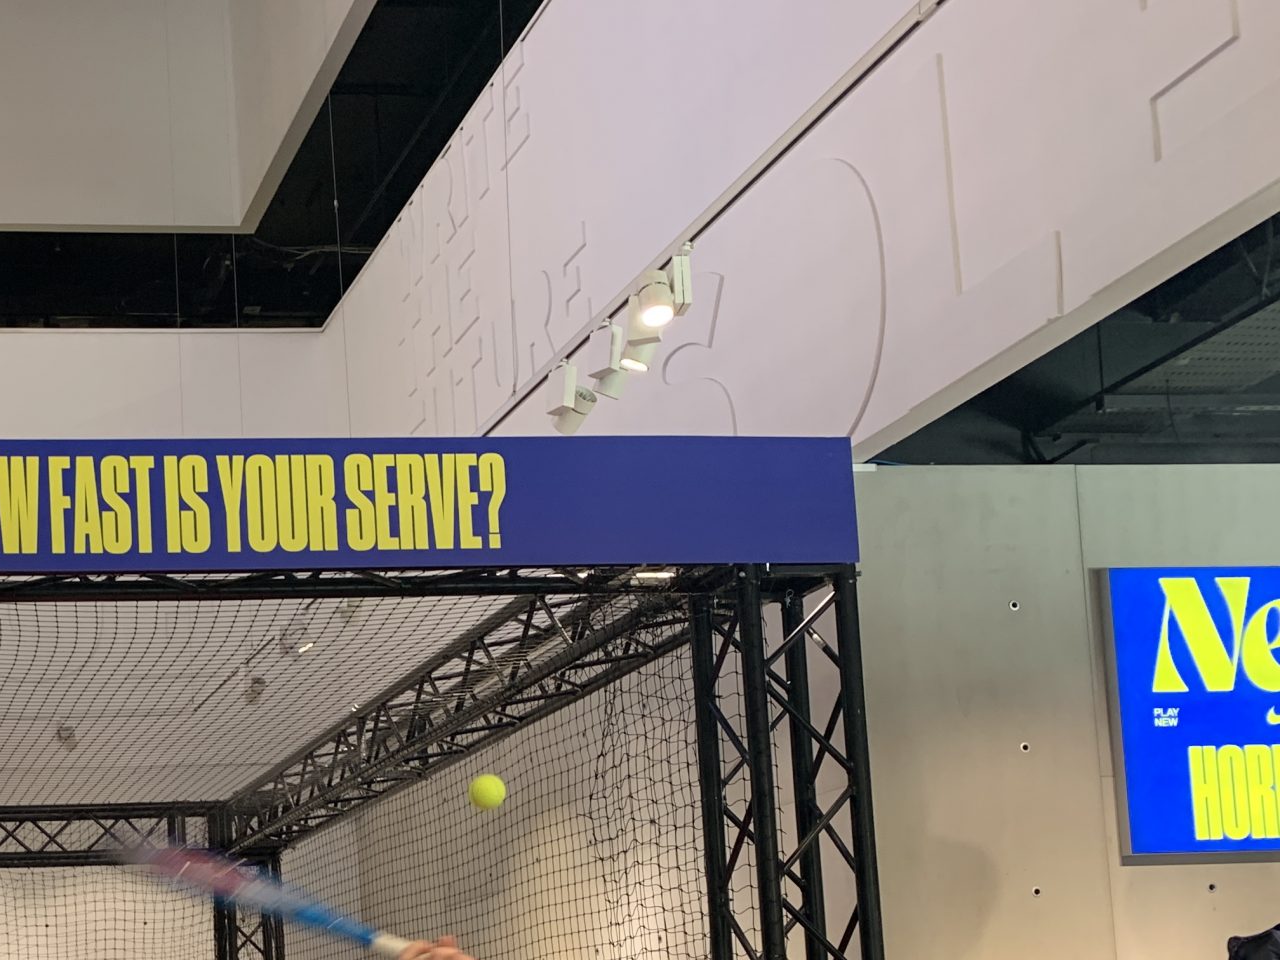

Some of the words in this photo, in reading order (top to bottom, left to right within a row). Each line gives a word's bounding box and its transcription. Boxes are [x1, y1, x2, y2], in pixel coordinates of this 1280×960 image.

[48, 455, 155, 554] FAST
[163, 454, 211, 553] IS
[216, 454, 337, 553] YOUR
[342, 452, 506, 551] SERVE?
[1153, 707, 1180, 717] PLAY
[1154, 717, 1179, 727] NEW
